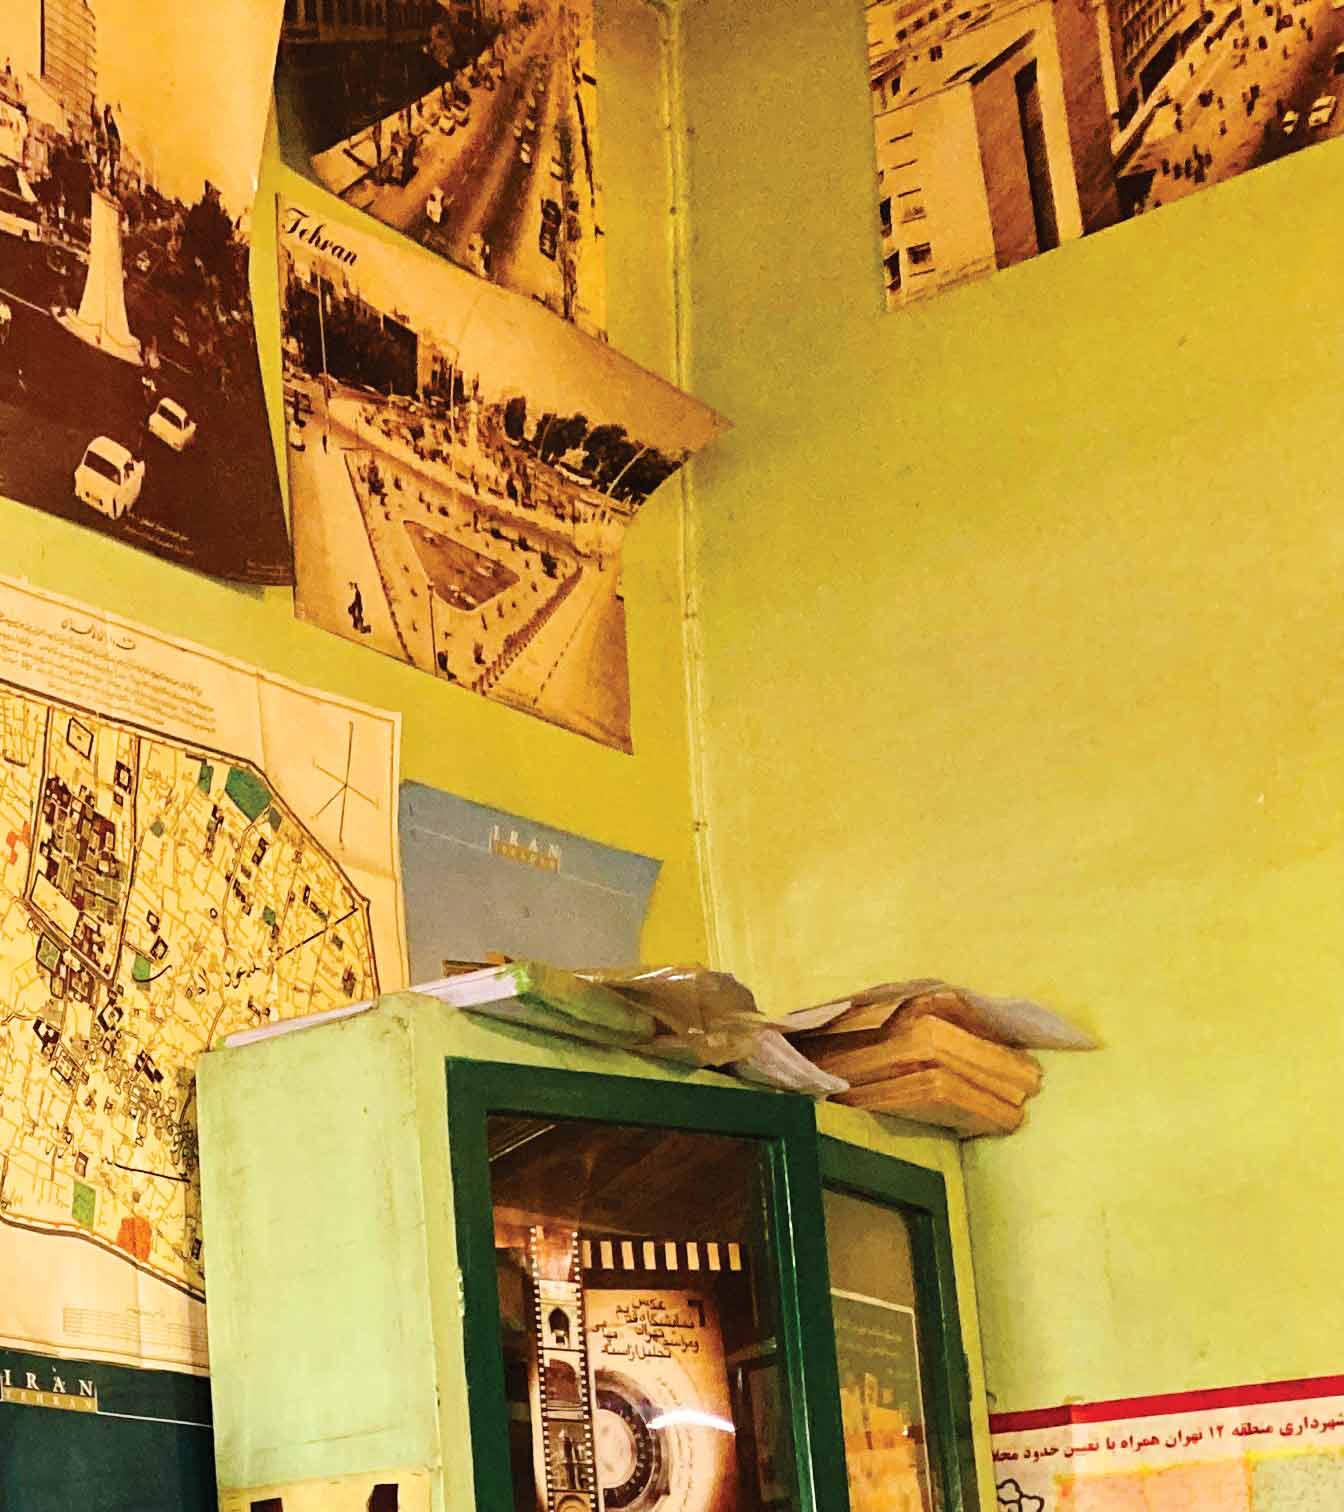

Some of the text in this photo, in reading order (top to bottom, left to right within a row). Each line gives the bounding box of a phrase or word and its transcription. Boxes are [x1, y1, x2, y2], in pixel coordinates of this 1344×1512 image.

[282, 208, 358, 266] Tehran
[494, 824, 559, 858] IRAN
[3, 1369, 93, 1397] IRAN
[1210, 1424, 1223, 1438] ۱۲
[1231, 1424, 1273, 1438] منطقه
[1106, 1436, 1116, 1450] با
[1120, 1435, 1160, 1451] همراه
[1165, 1430, 1203, 1449] تهران
[992, 1448, 1019, 1463] محلا
[1023, 1446, 1060, 1462] حدود
